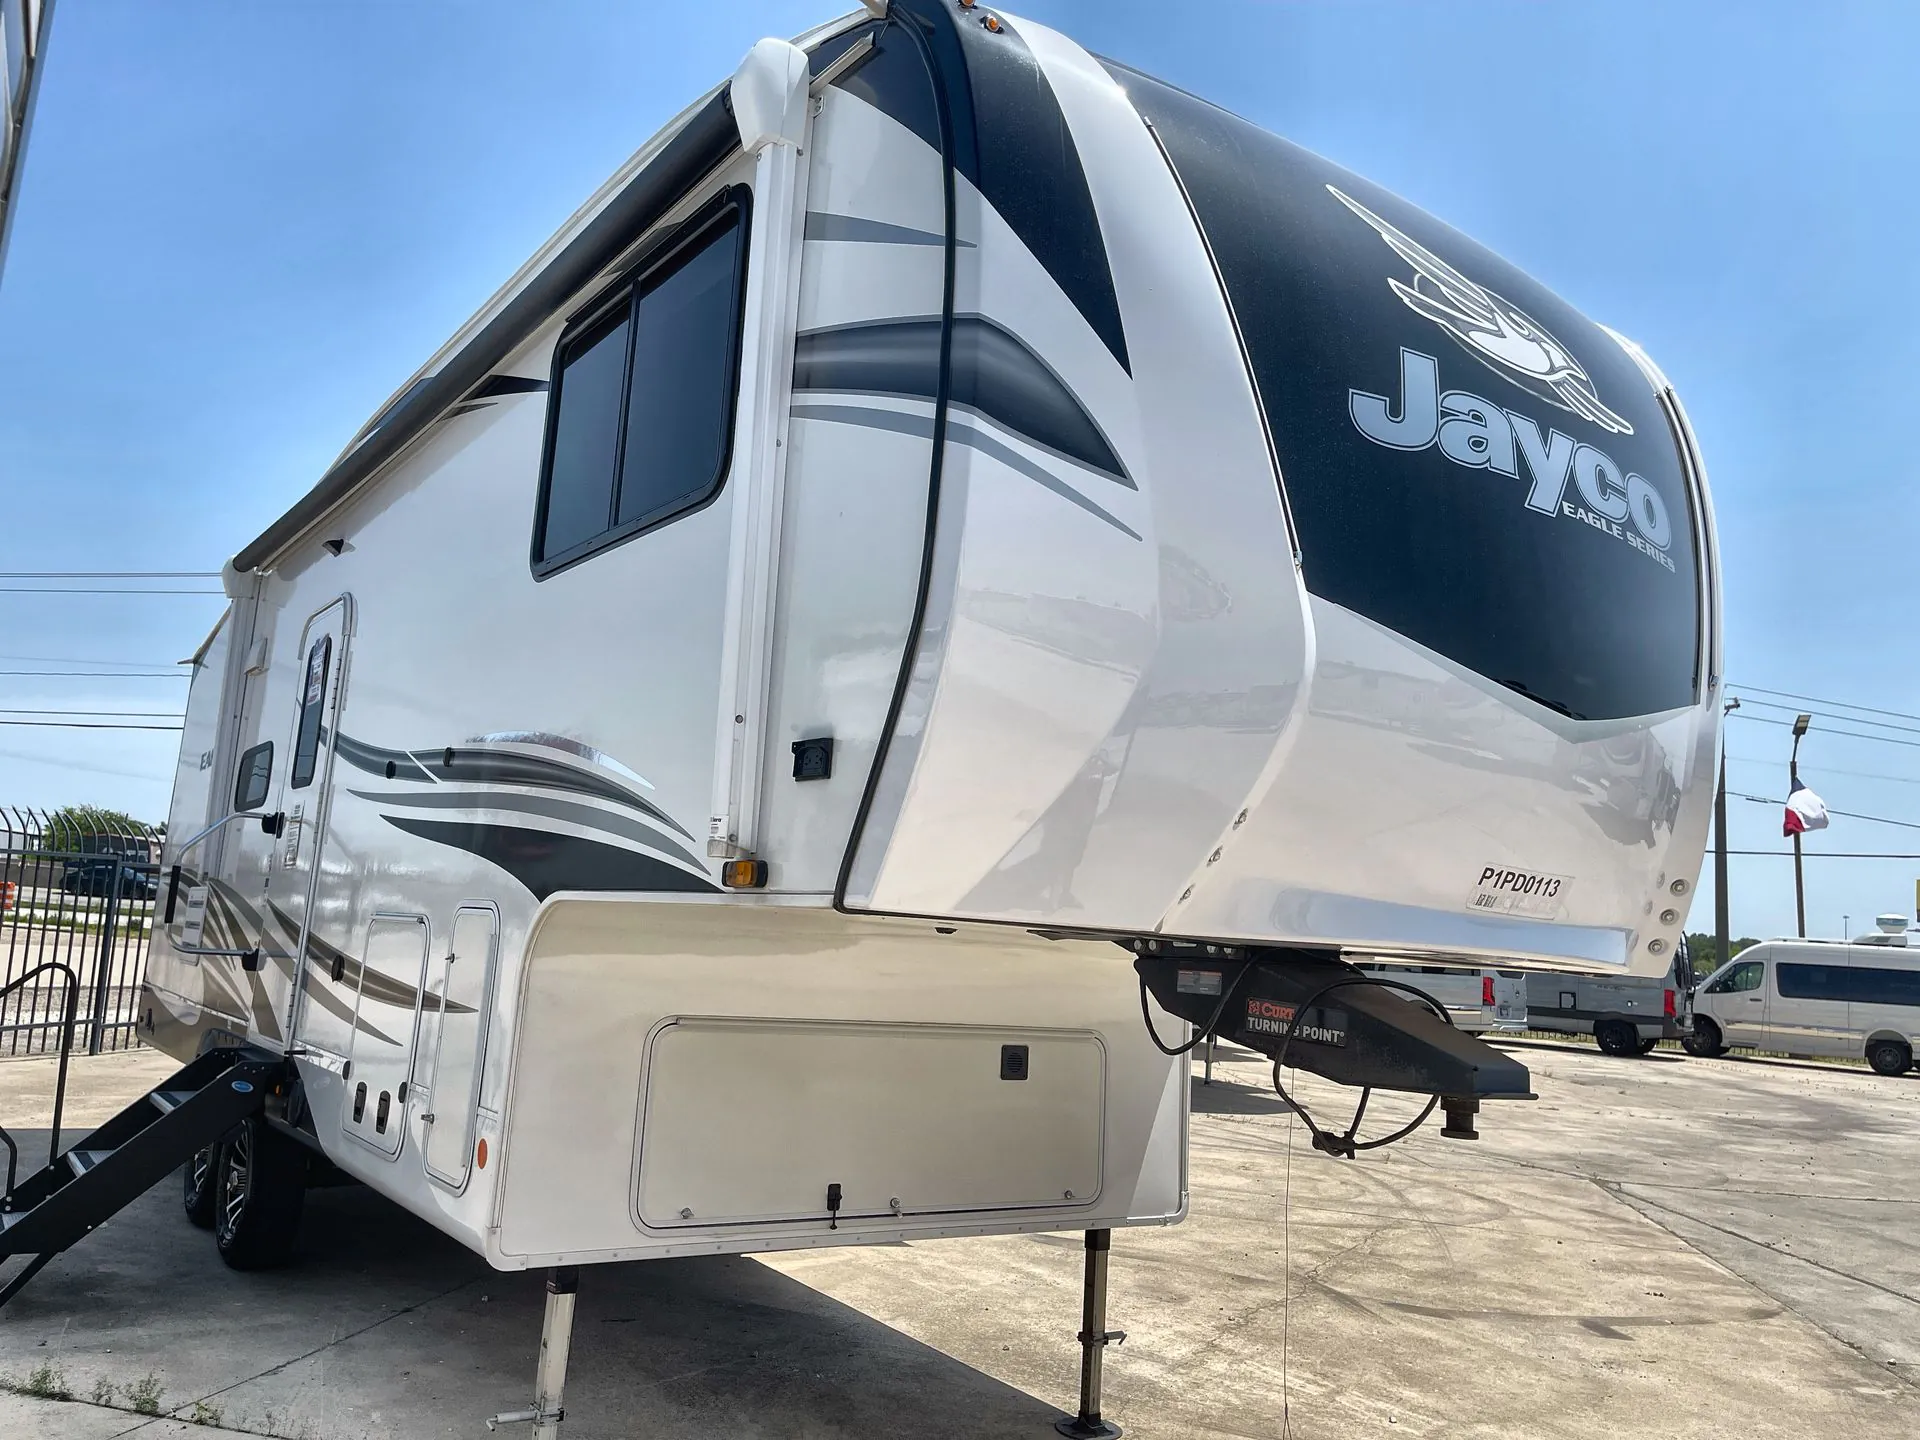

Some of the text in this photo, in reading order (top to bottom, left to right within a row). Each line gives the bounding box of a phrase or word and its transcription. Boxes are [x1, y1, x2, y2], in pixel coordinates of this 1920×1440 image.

[1349, 346, 1672, 552] Jayco
[1562, 501, 1676, 573] EAGLE SERIES
[1478, 867, 1561, 897] P1PD0113
